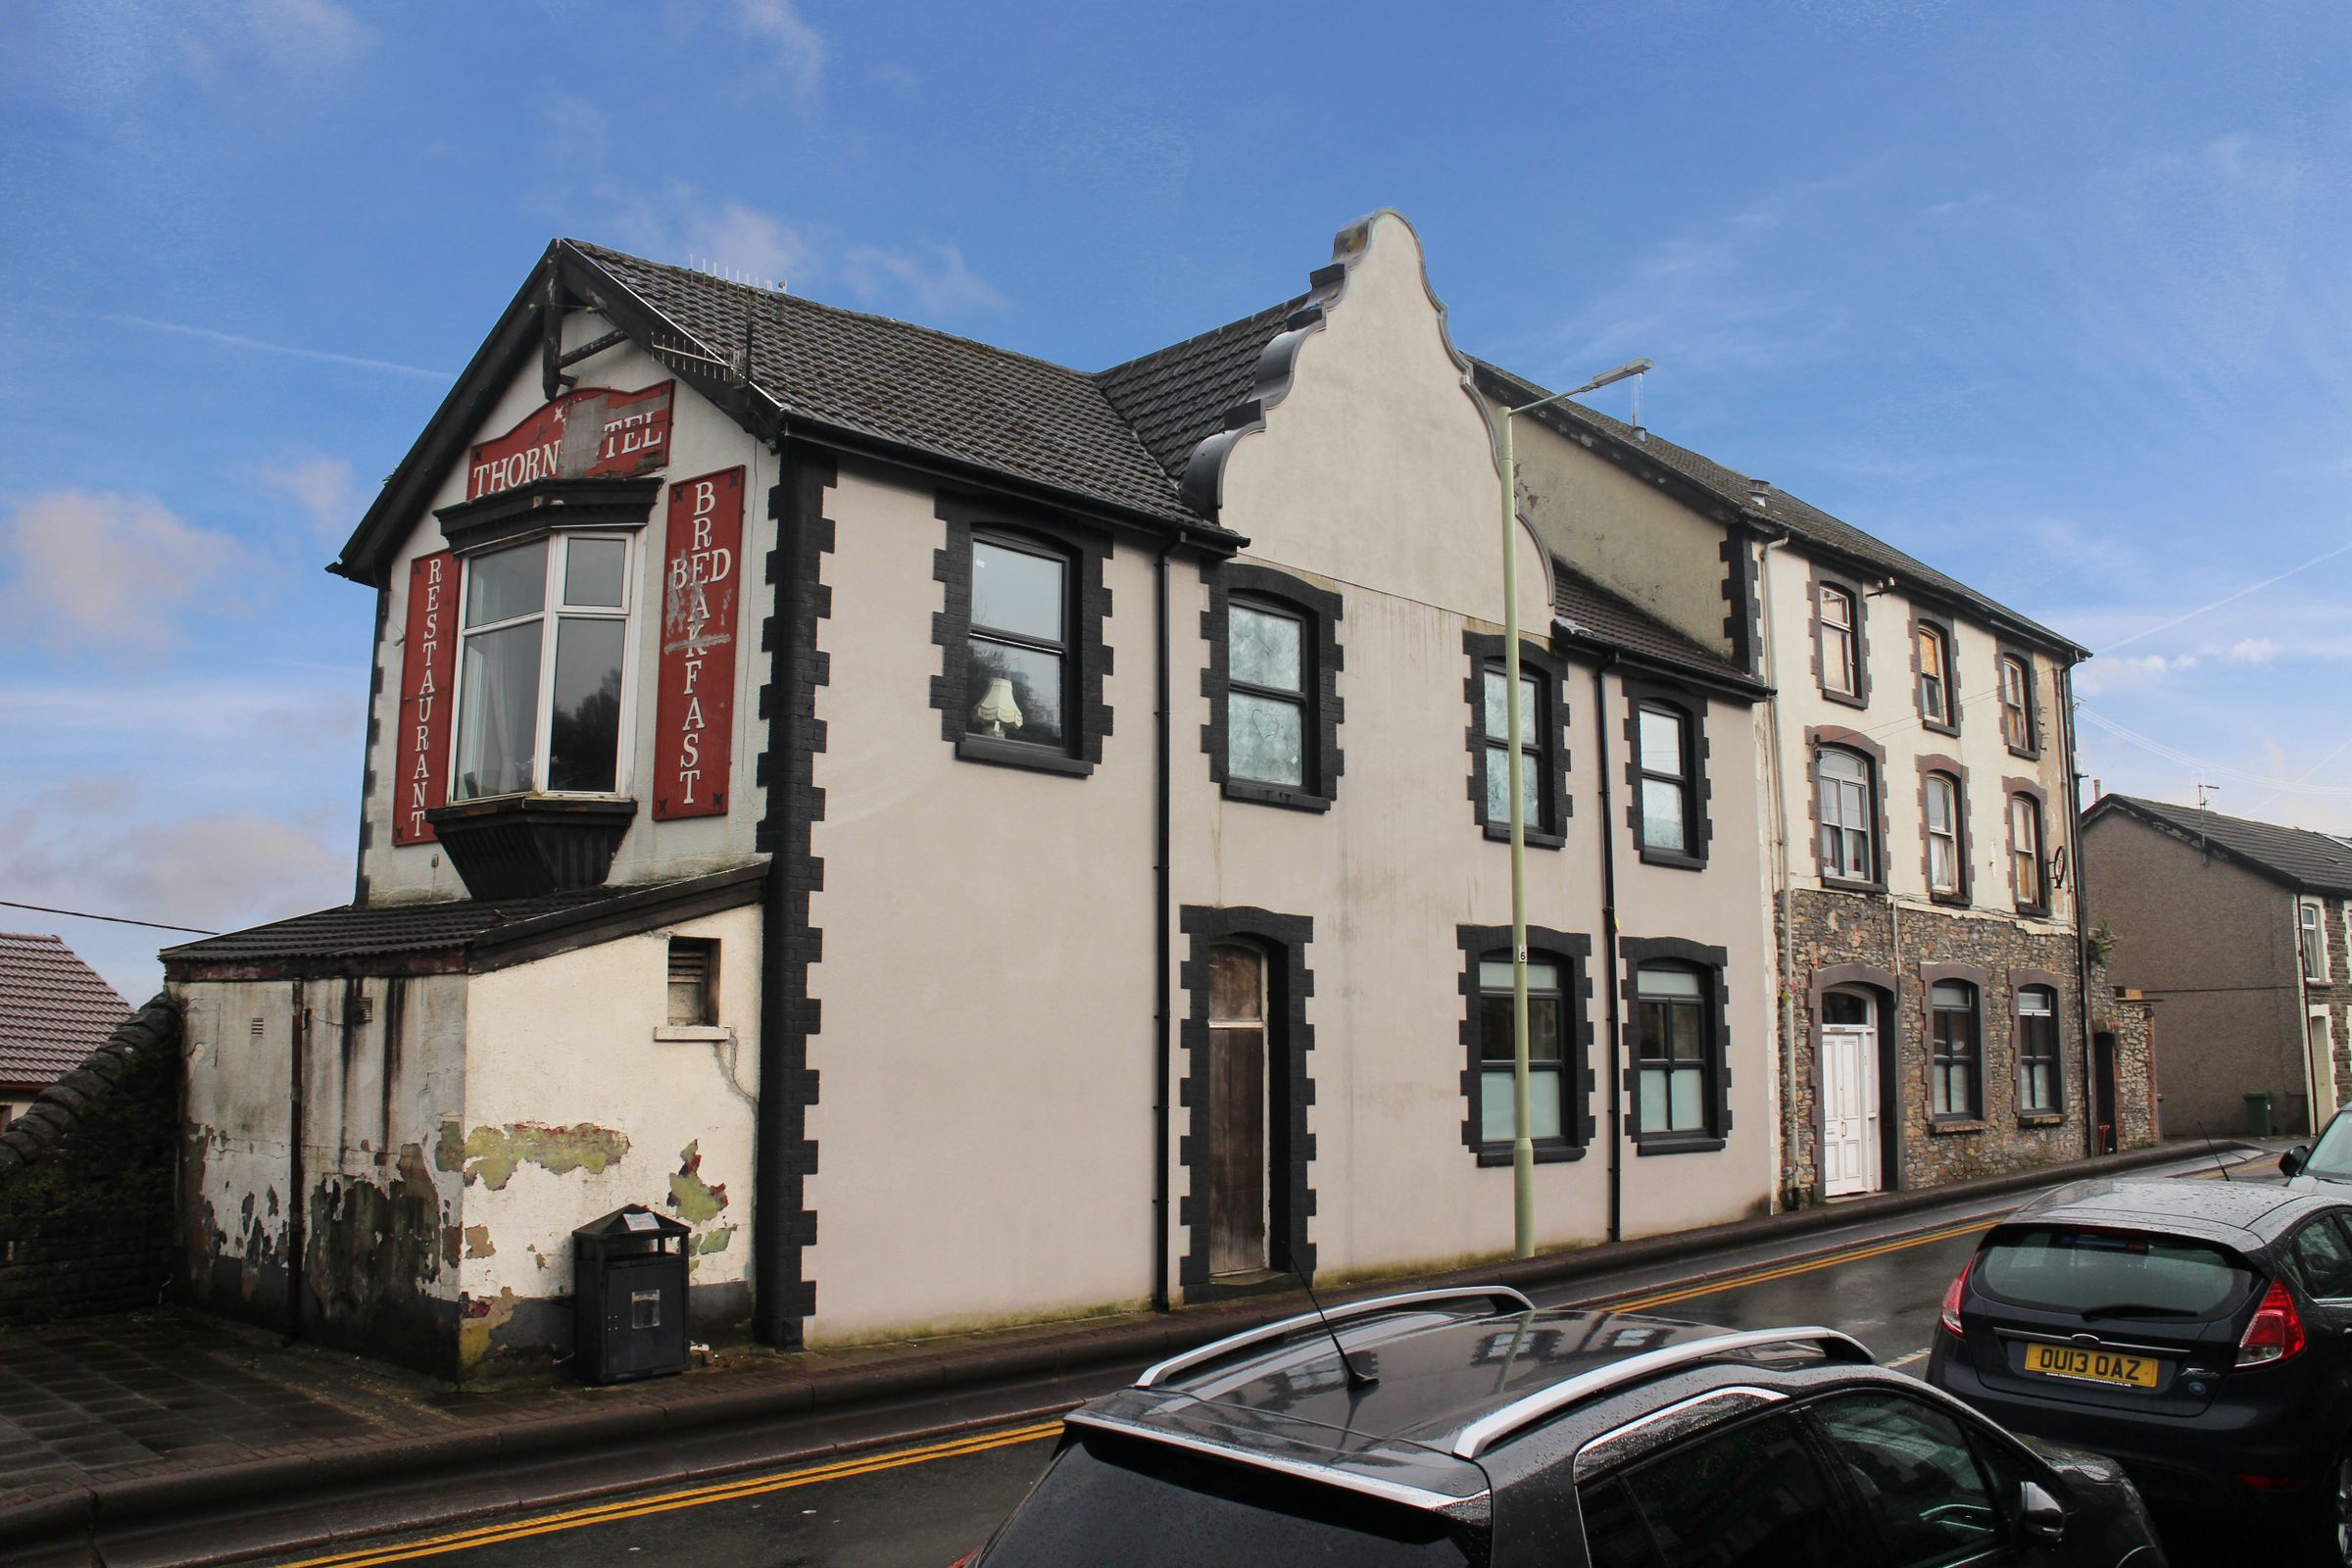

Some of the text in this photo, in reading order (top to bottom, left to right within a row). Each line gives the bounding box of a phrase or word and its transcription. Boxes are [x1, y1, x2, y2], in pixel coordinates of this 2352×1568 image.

[473, 411, 662, 499] THORN TEL
[671, 548, 732, 590] BED
[679, 481, 715, 804] BREAKFAST
[411, 559, 442, 837] RESTAURANT
[2039, 1348, 2089, 1373] OU13
[2094, 1354, 2141, 1381] OAZ
